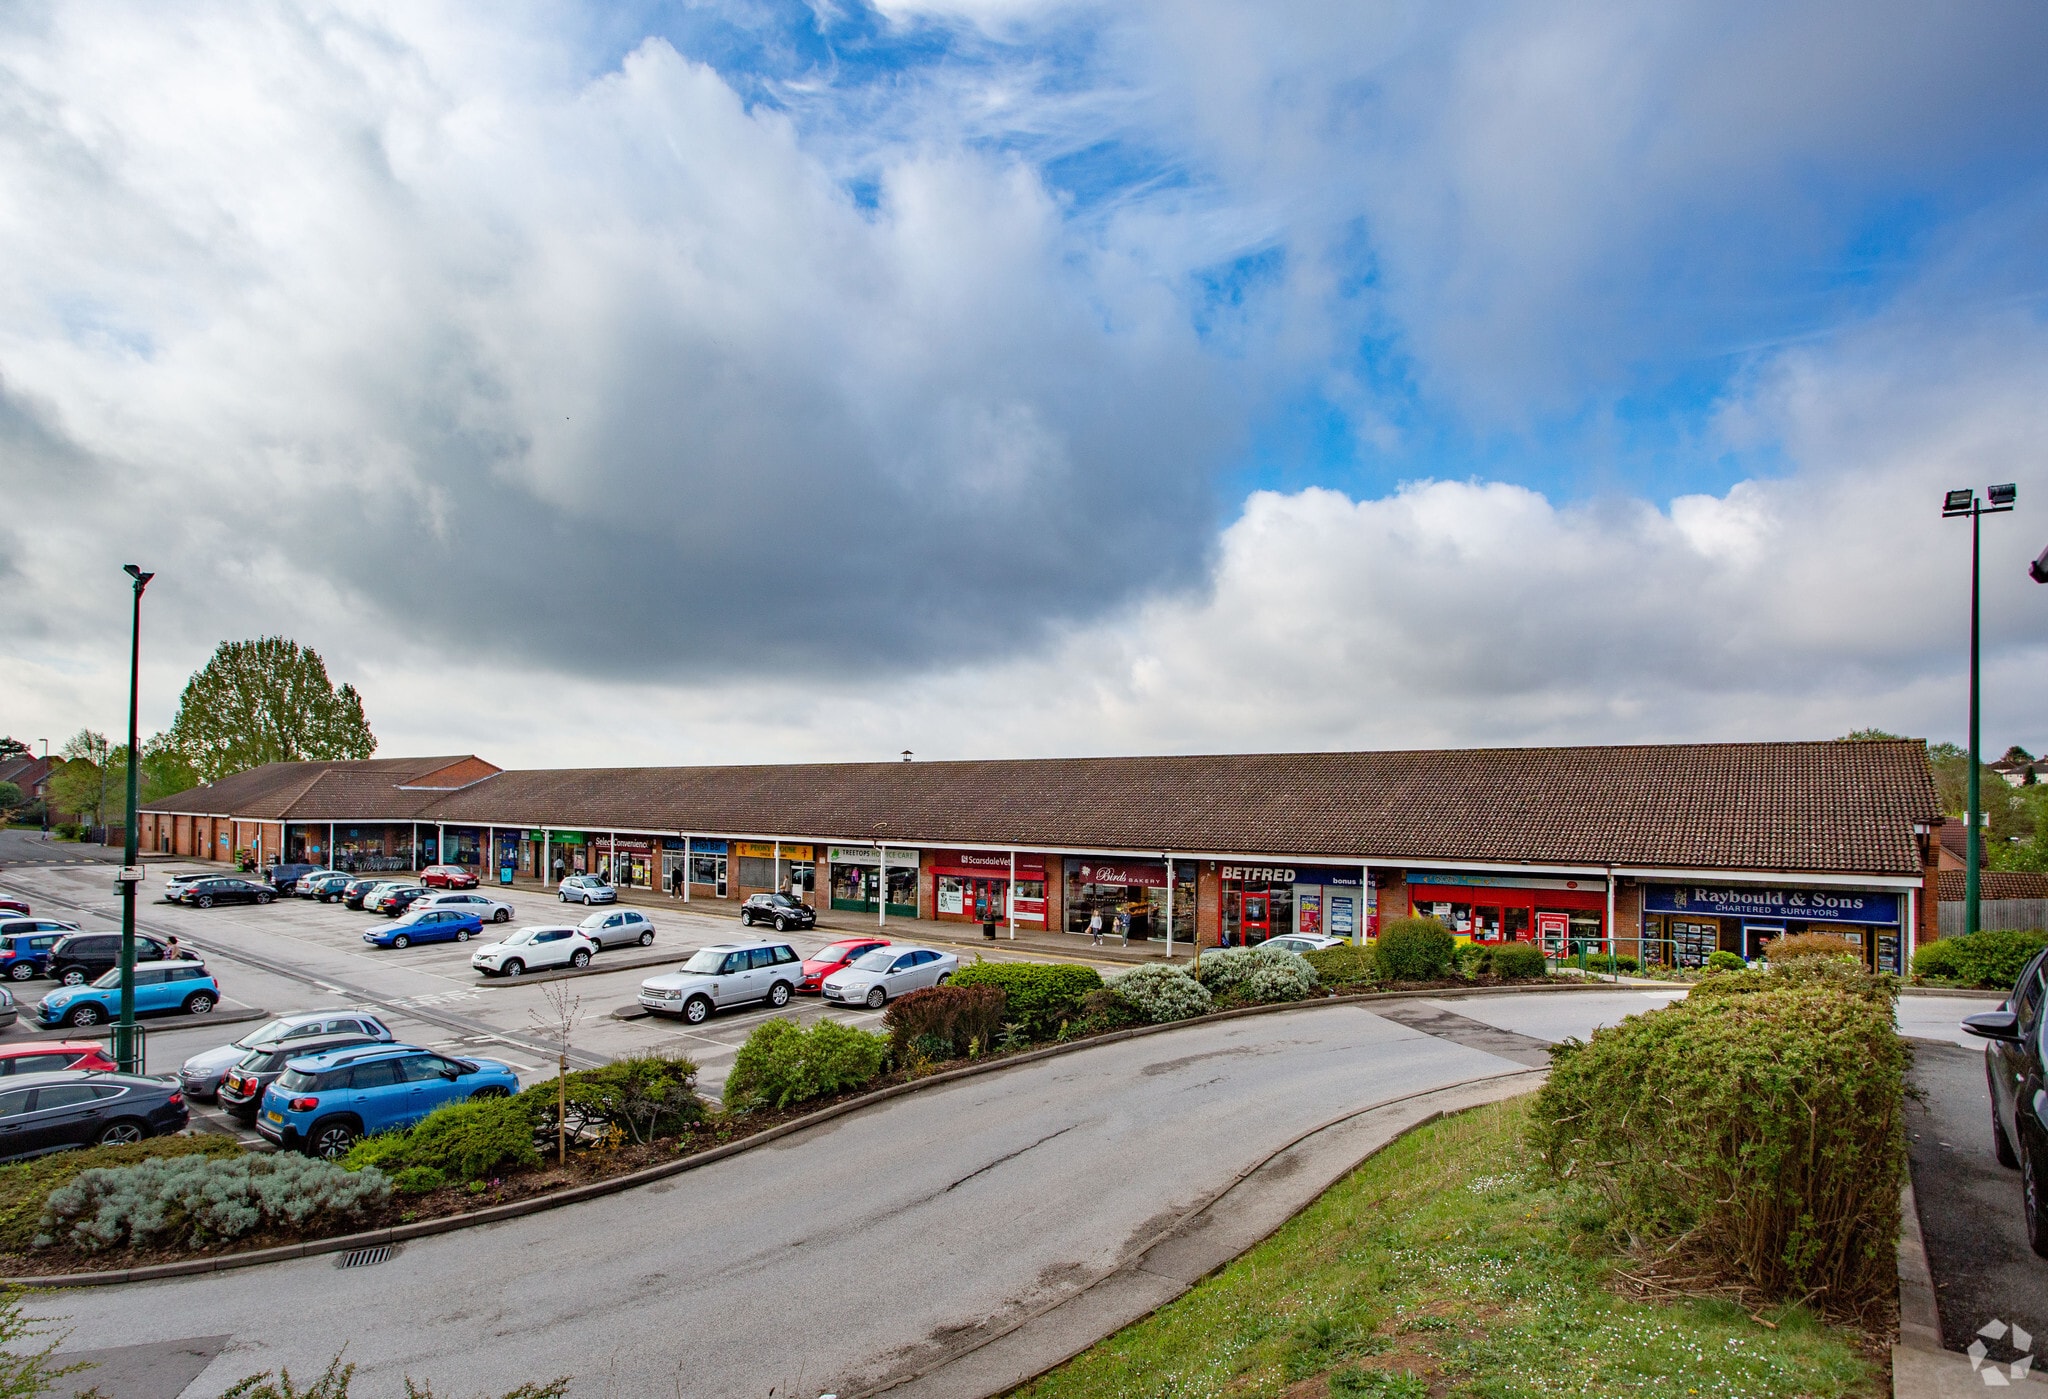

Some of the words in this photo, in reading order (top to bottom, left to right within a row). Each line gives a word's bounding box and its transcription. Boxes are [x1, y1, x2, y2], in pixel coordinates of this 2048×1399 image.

[596, 837, 612, 846] Selec
[842, 849, 870, 857] TREETOPS
[968, 855, 1000, 866] Scarsdale
[1095, 866, 1127, 882] Birds
[1221, 866, 1296, 882] BETFRED
[1332, 877, 1357, 885] bonus
[1694, 888, 1784, 905] Raybould
[1789, 892, 1806, 907] &
[1811, 893, 1864, 909] Sons
[1715, 904, 1772, 914] CHARTERED
[1780, 907, 1840, 918] SURVEYORS
